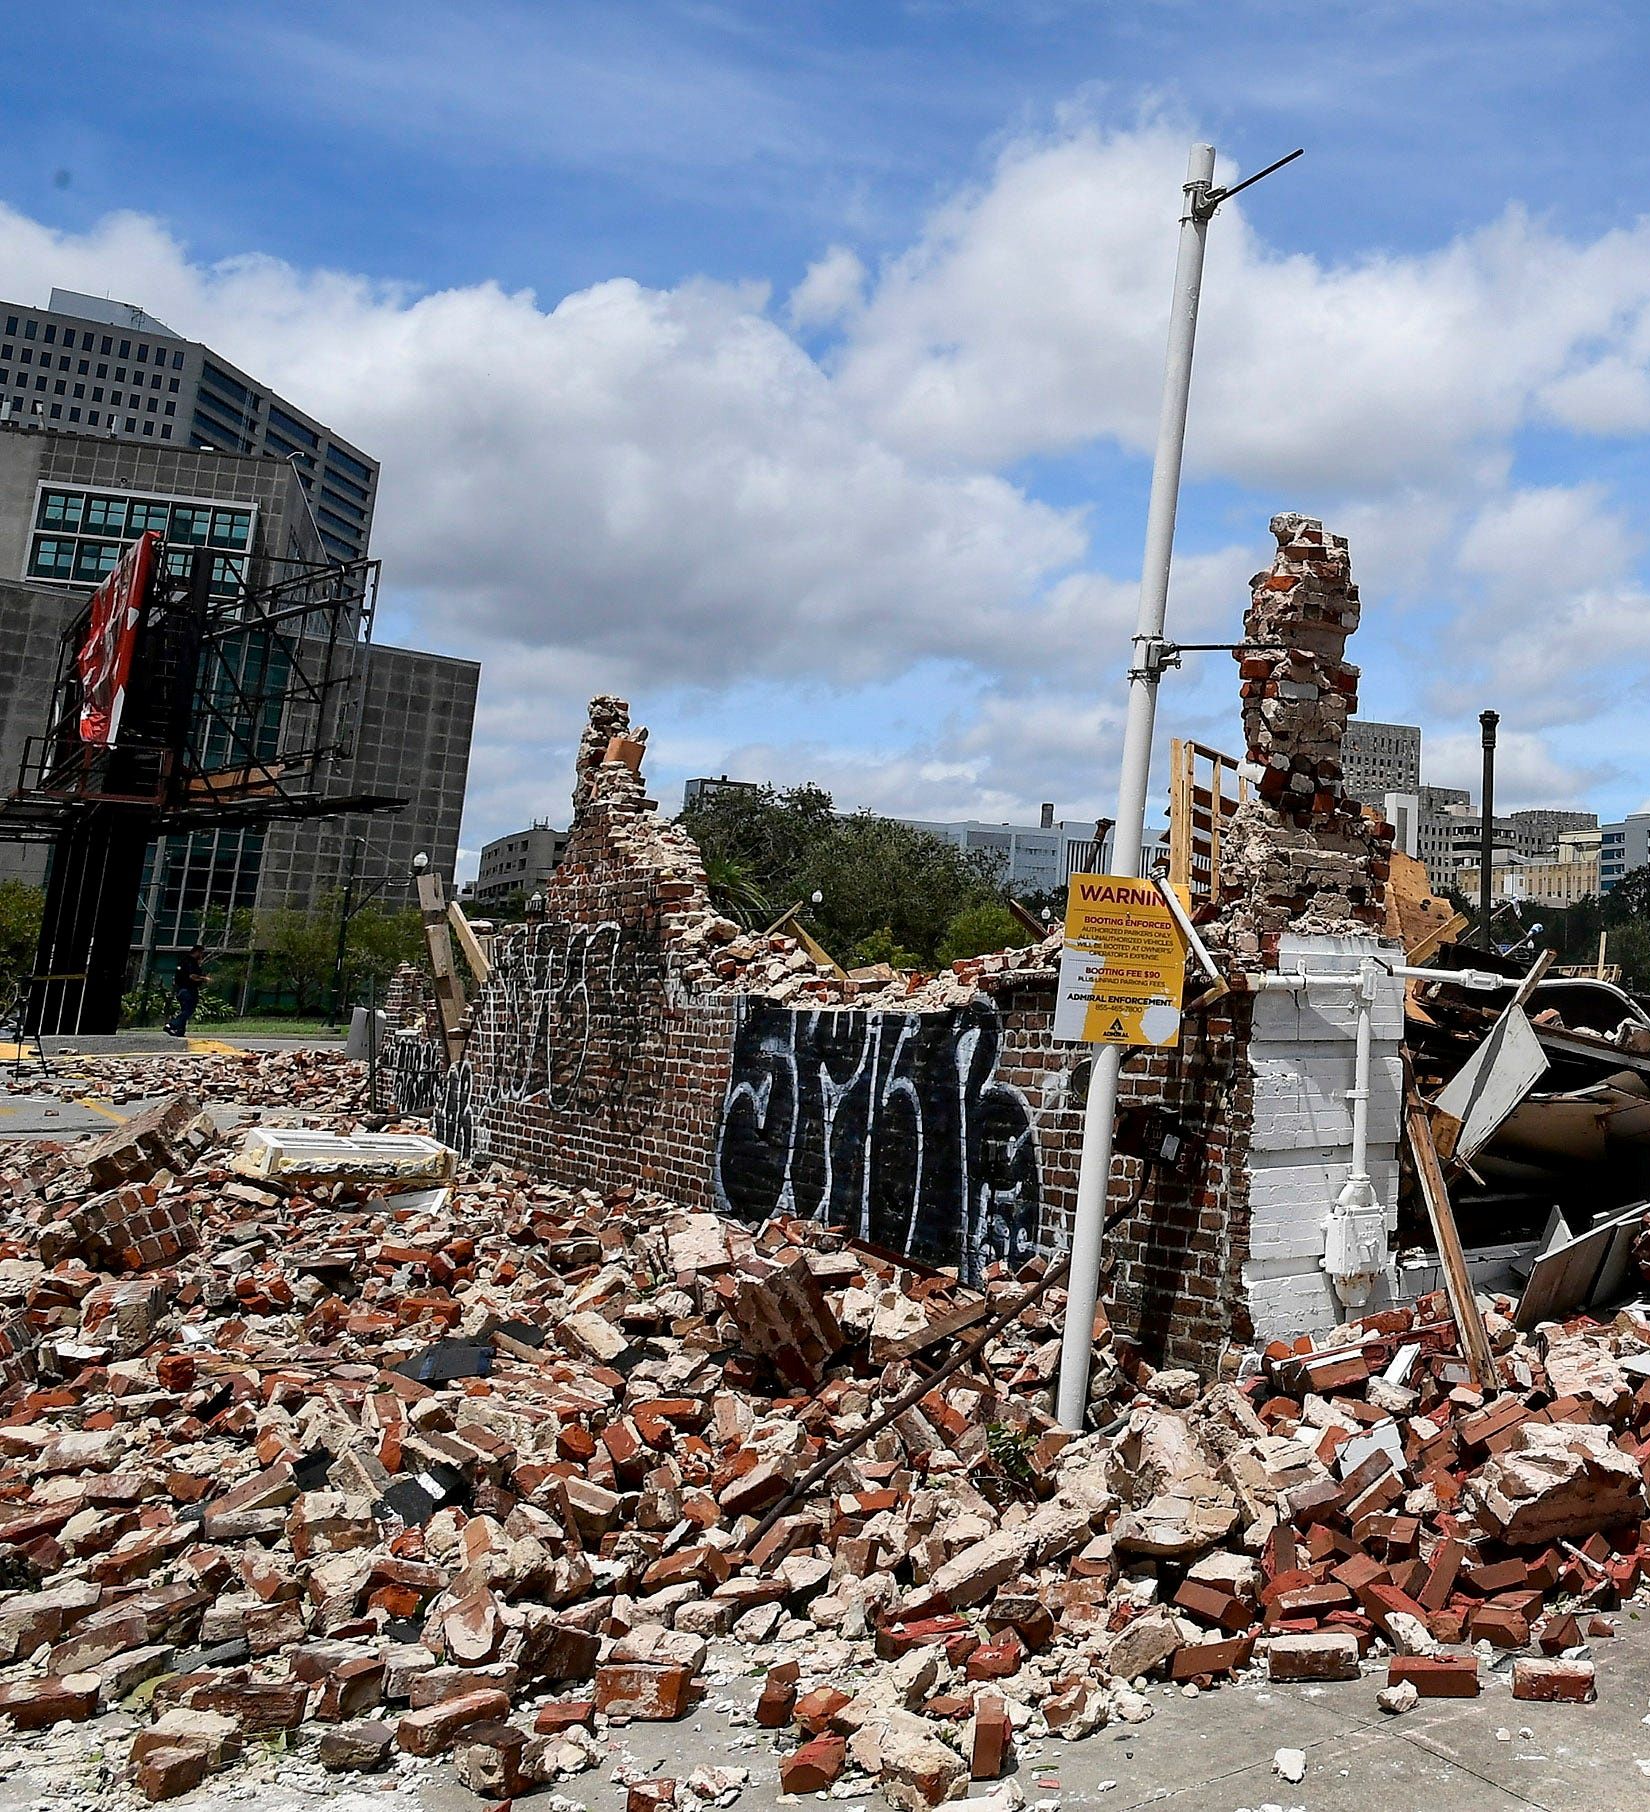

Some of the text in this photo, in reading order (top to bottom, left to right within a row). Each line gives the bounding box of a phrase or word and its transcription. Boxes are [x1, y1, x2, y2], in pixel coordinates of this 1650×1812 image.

[1080, 885, 1178, 908] WARNIN
[1085, 916, 1171, 930] BOOTING ENFORCED
[1082, 926, 1123, 935] AUTHORIZED
[1124, 929, 1152, 937] PARKERS
[1092, 935, 1142, 944] UNAUTHORIZED
[1086, 967, 1124, 976] BOOTING
[1144, 970, 1160, 979] $90
[1067, 993, 1172, 1006] ADMIRAL ENFORCEMENT
